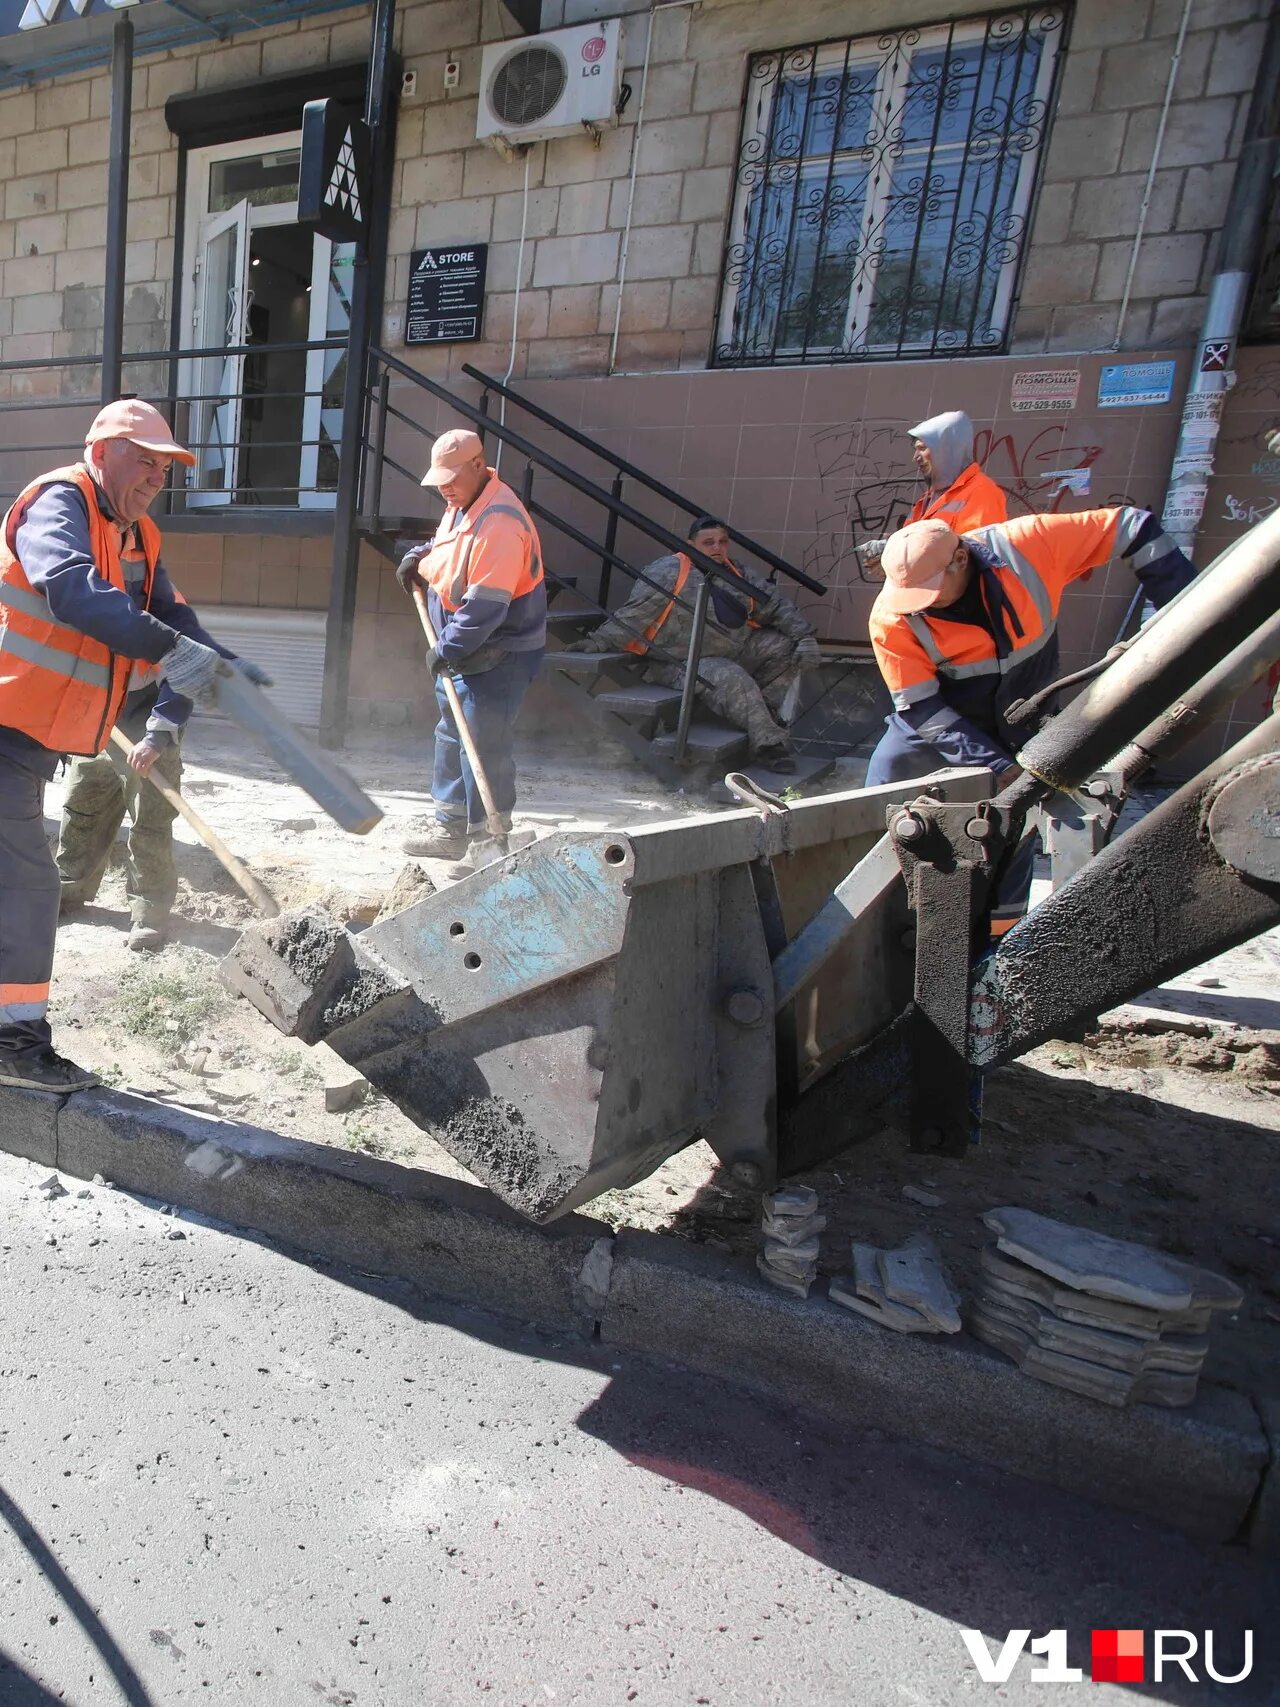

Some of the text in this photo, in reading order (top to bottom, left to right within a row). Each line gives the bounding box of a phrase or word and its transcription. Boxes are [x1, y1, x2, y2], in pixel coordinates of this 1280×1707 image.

[582, 64, 601, 78] LG
[439, 251, 475, 264] STORE
[1015, 377, 1077, 385] ПОМОЩЬ
